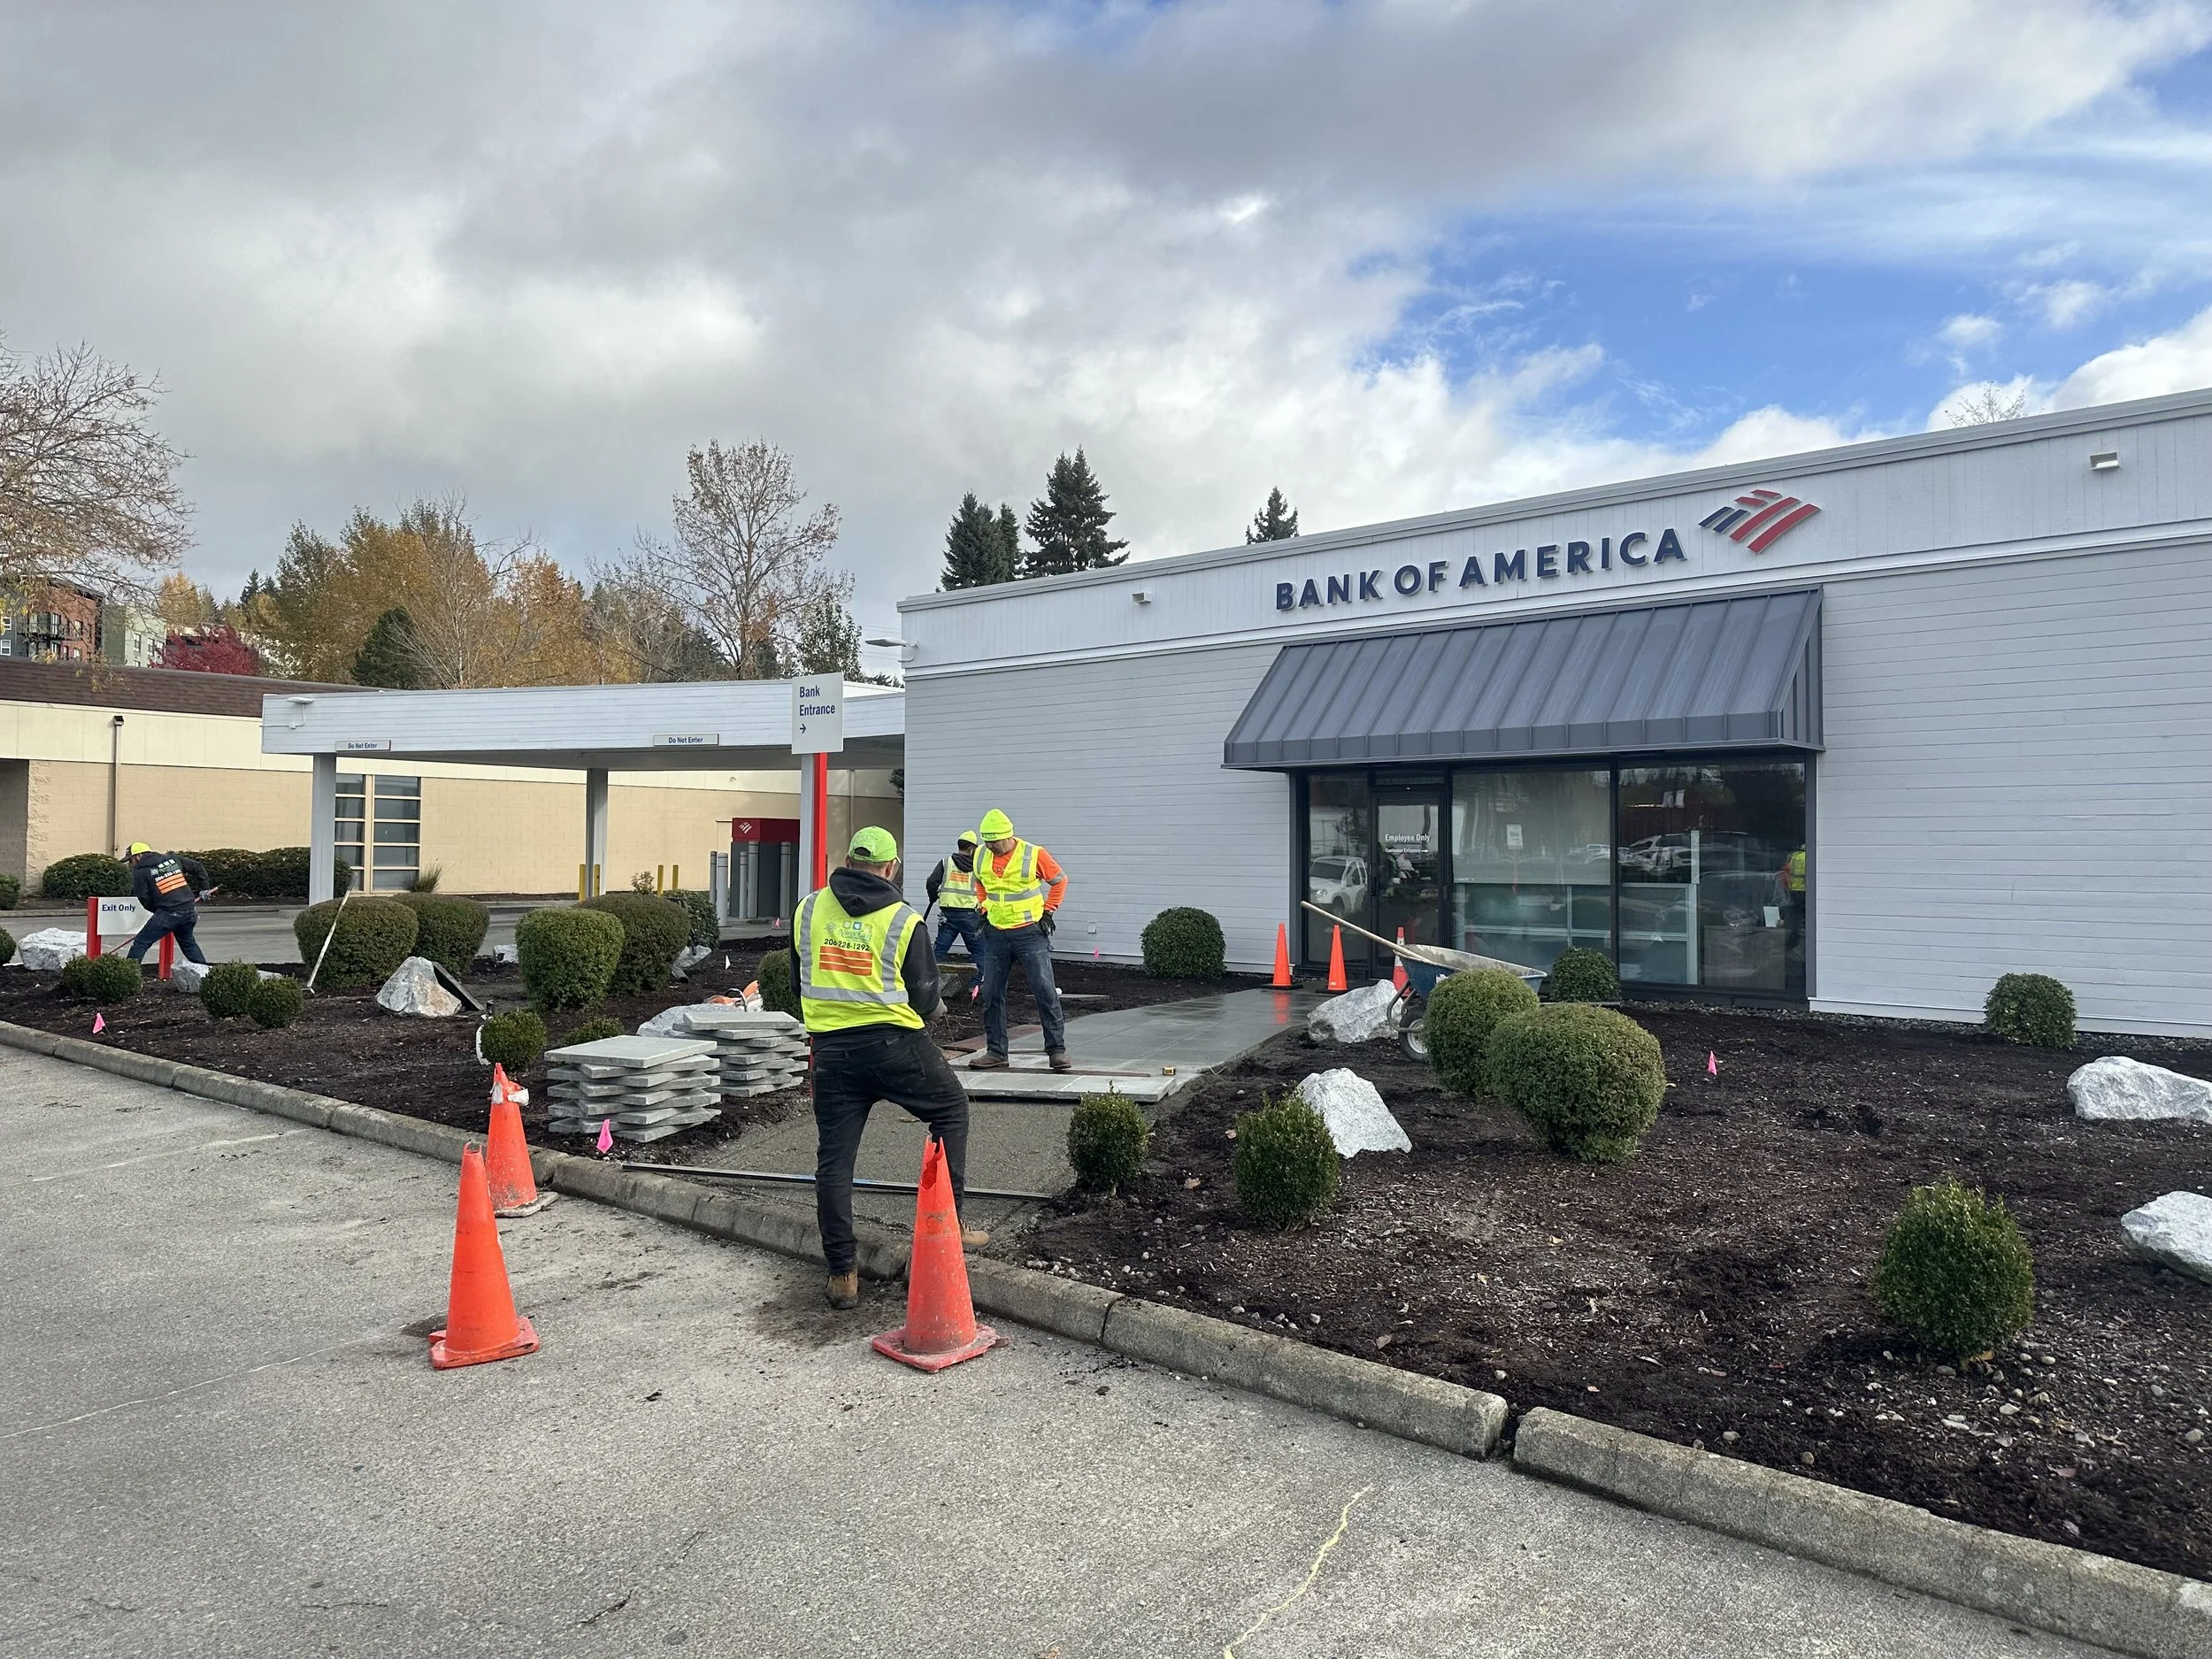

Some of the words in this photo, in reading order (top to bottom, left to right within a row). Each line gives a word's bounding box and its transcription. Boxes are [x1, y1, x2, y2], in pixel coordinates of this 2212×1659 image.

[1276, 569, 1383, 611] BANK
[1394, 560, 1449, 596] OF
[1458, 528, 1687, 588] AMERICA
[799, 685, 820, 698] Bank
[799, 704, 835, 716] Entrance
[1385, 833, 1416, 843] Employee
[1416, 833, 1431, 843] Only
[118, 903, 136, 913] Only
